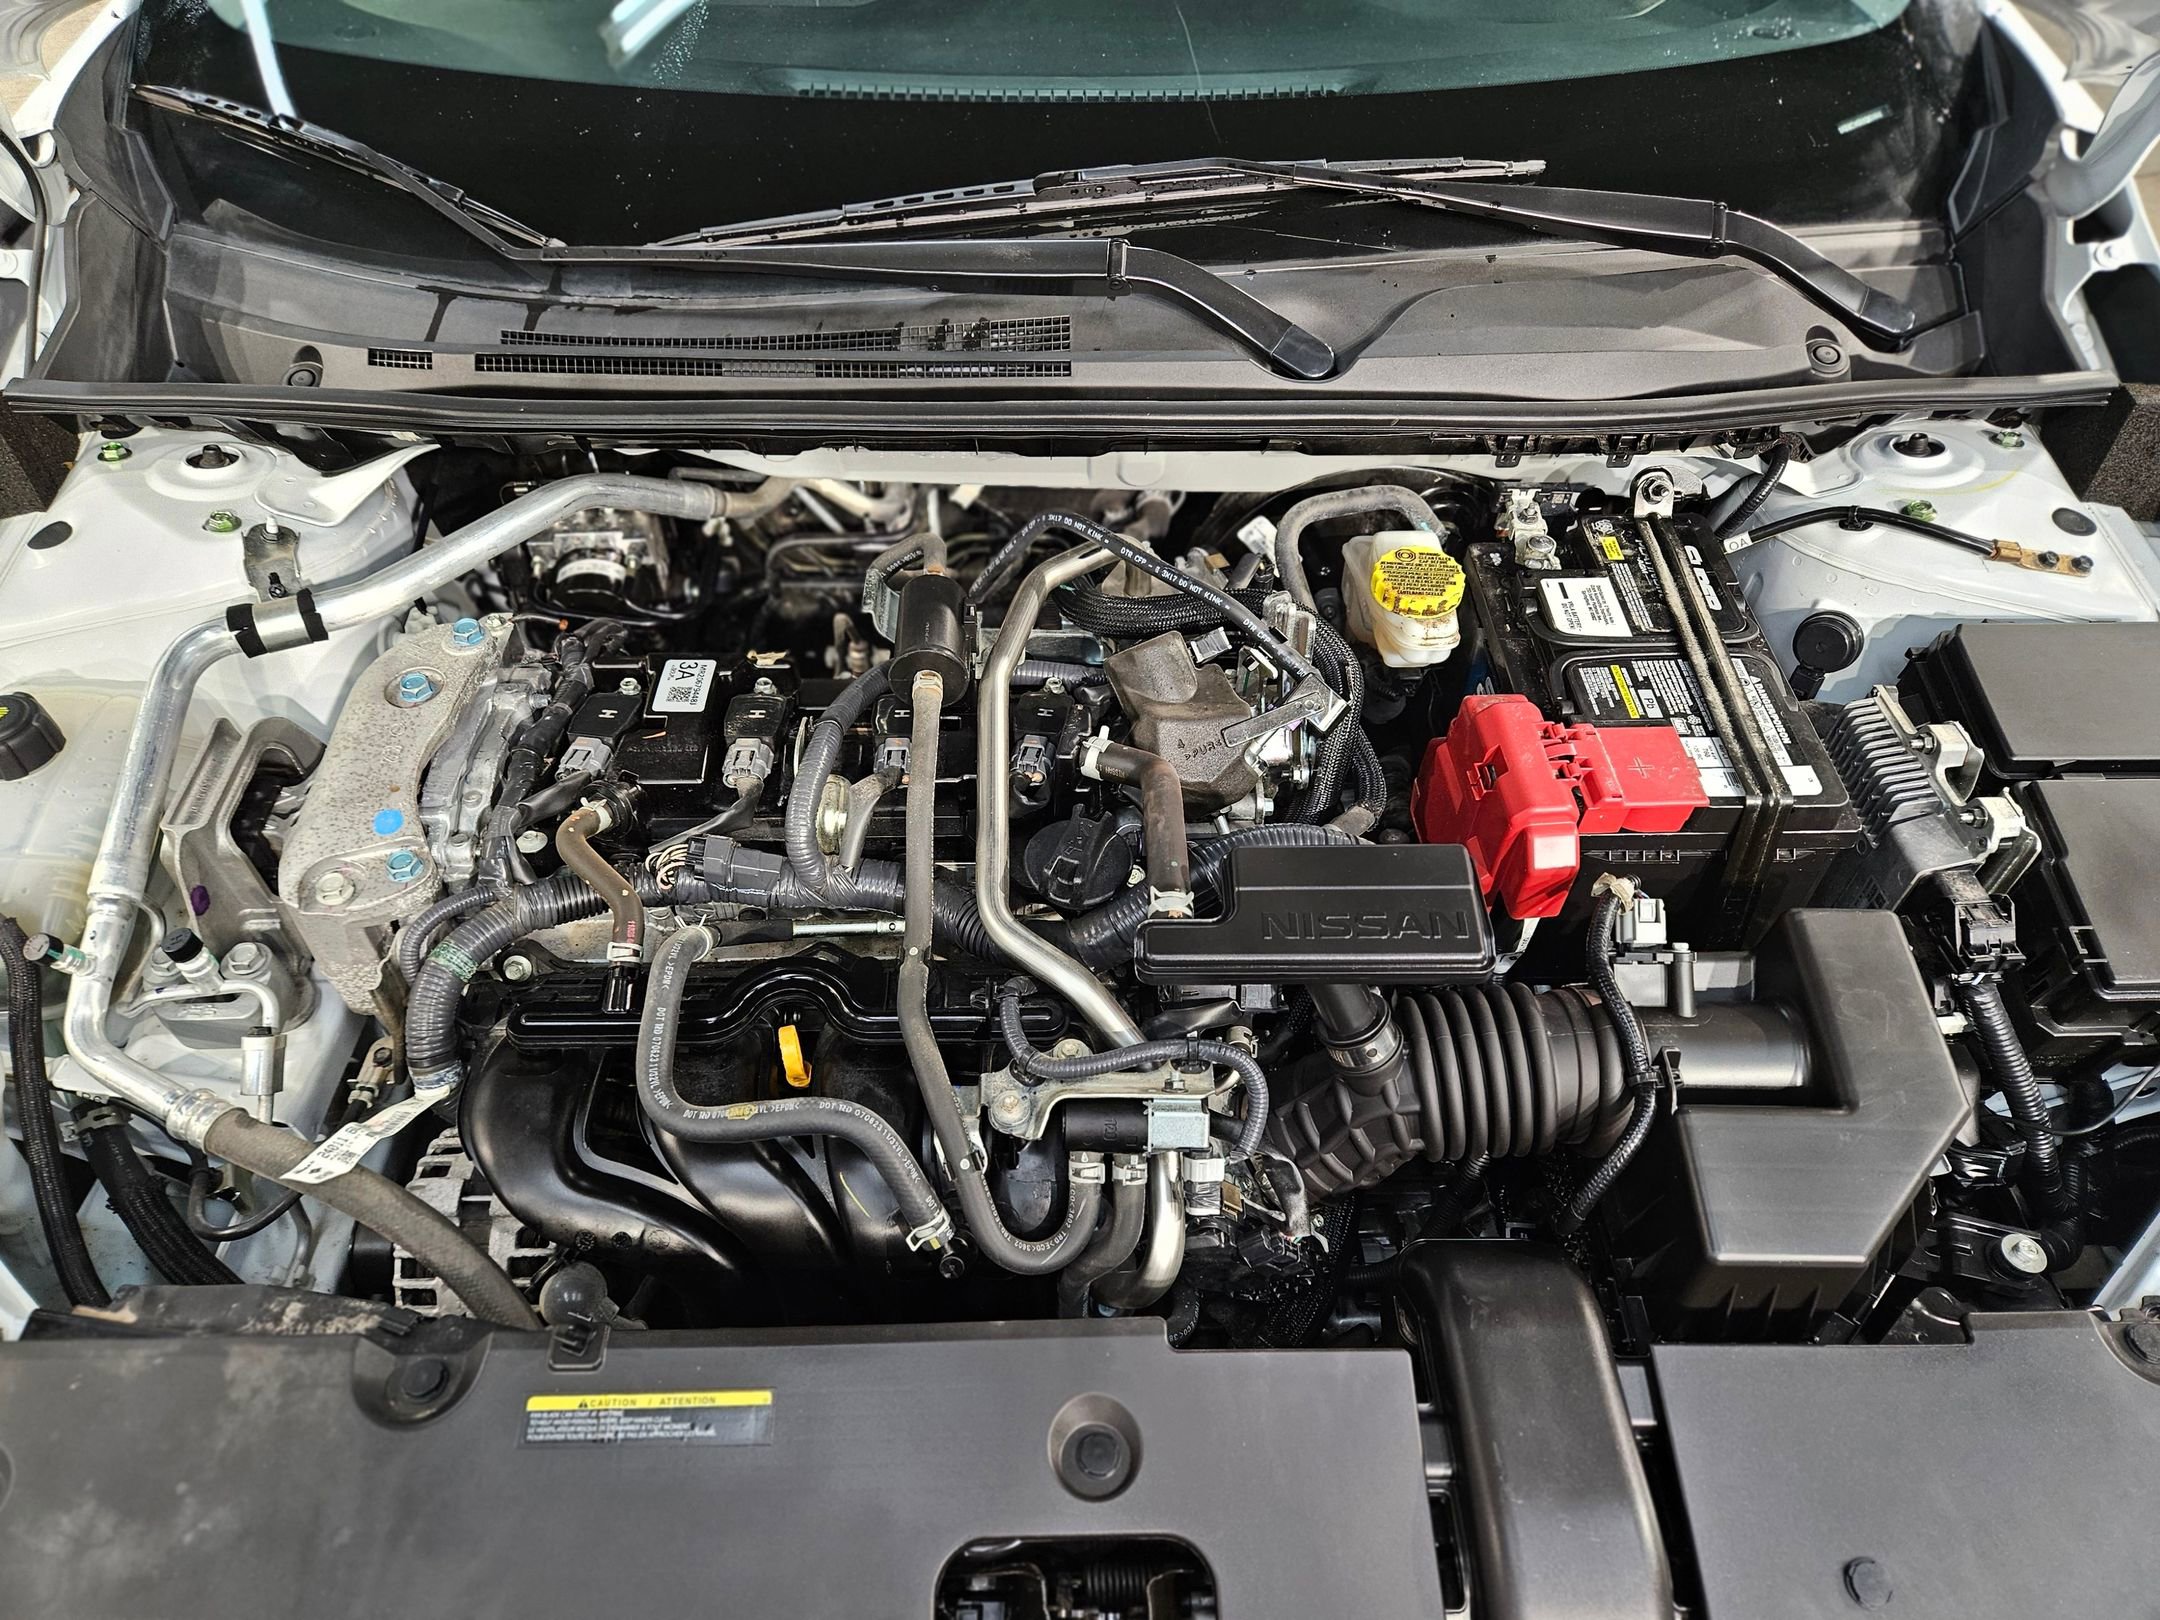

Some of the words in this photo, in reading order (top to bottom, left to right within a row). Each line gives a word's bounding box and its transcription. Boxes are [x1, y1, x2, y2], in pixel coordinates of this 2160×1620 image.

[1074, 521, 1086, 532] NOT
[1087, 528, 1103, 541] KINK
[1178, 579, 1188, 588] DO
[1189, 584, 1203, 594] NOT
[1204, 591, 1223, 605] KINK
[675, 661, 699, 681] 3A
[1646, 697, 1654, 710] Pb
[1262, 910, 1470, 940] NISSAN
[656, 1007, 666, 1020] DOT
[659, 1396, 716, 1406] ATTENTION
